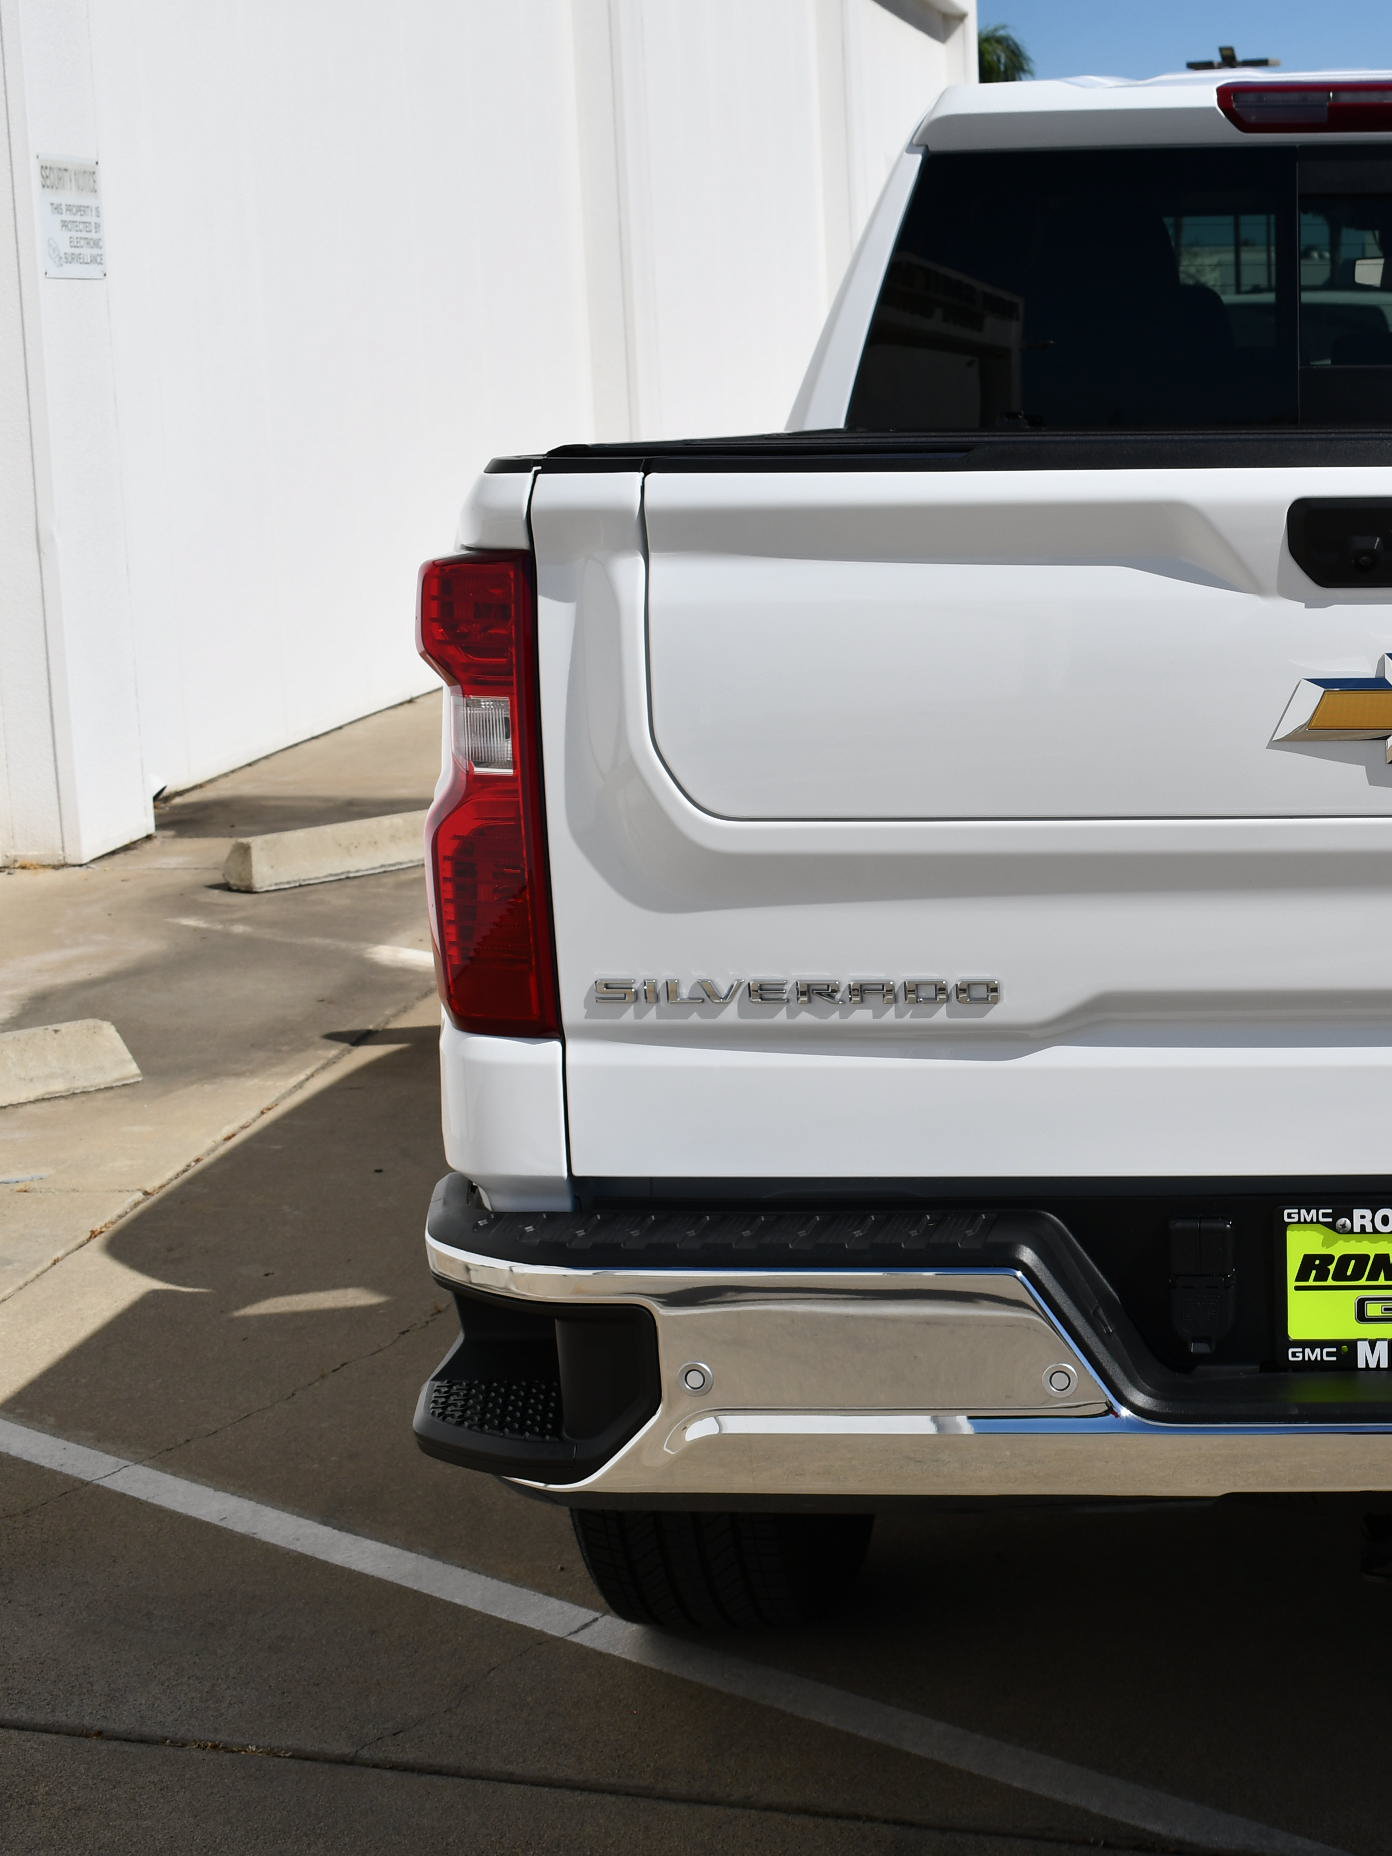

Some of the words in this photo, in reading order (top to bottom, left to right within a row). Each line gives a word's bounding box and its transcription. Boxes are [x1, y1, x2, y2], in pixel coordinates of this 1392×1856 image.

[65, 203, 93, 217] PROPERTY
[60, 219, 92, 233] PROTECTED
[69, 236, 103, 249] ELECTRONIC
[594, 978, 1001, 1005] SILVERADO
[1283, 1208, 1333, 1223] GMC
[1288, 1347, 1337, 1362] GMC
